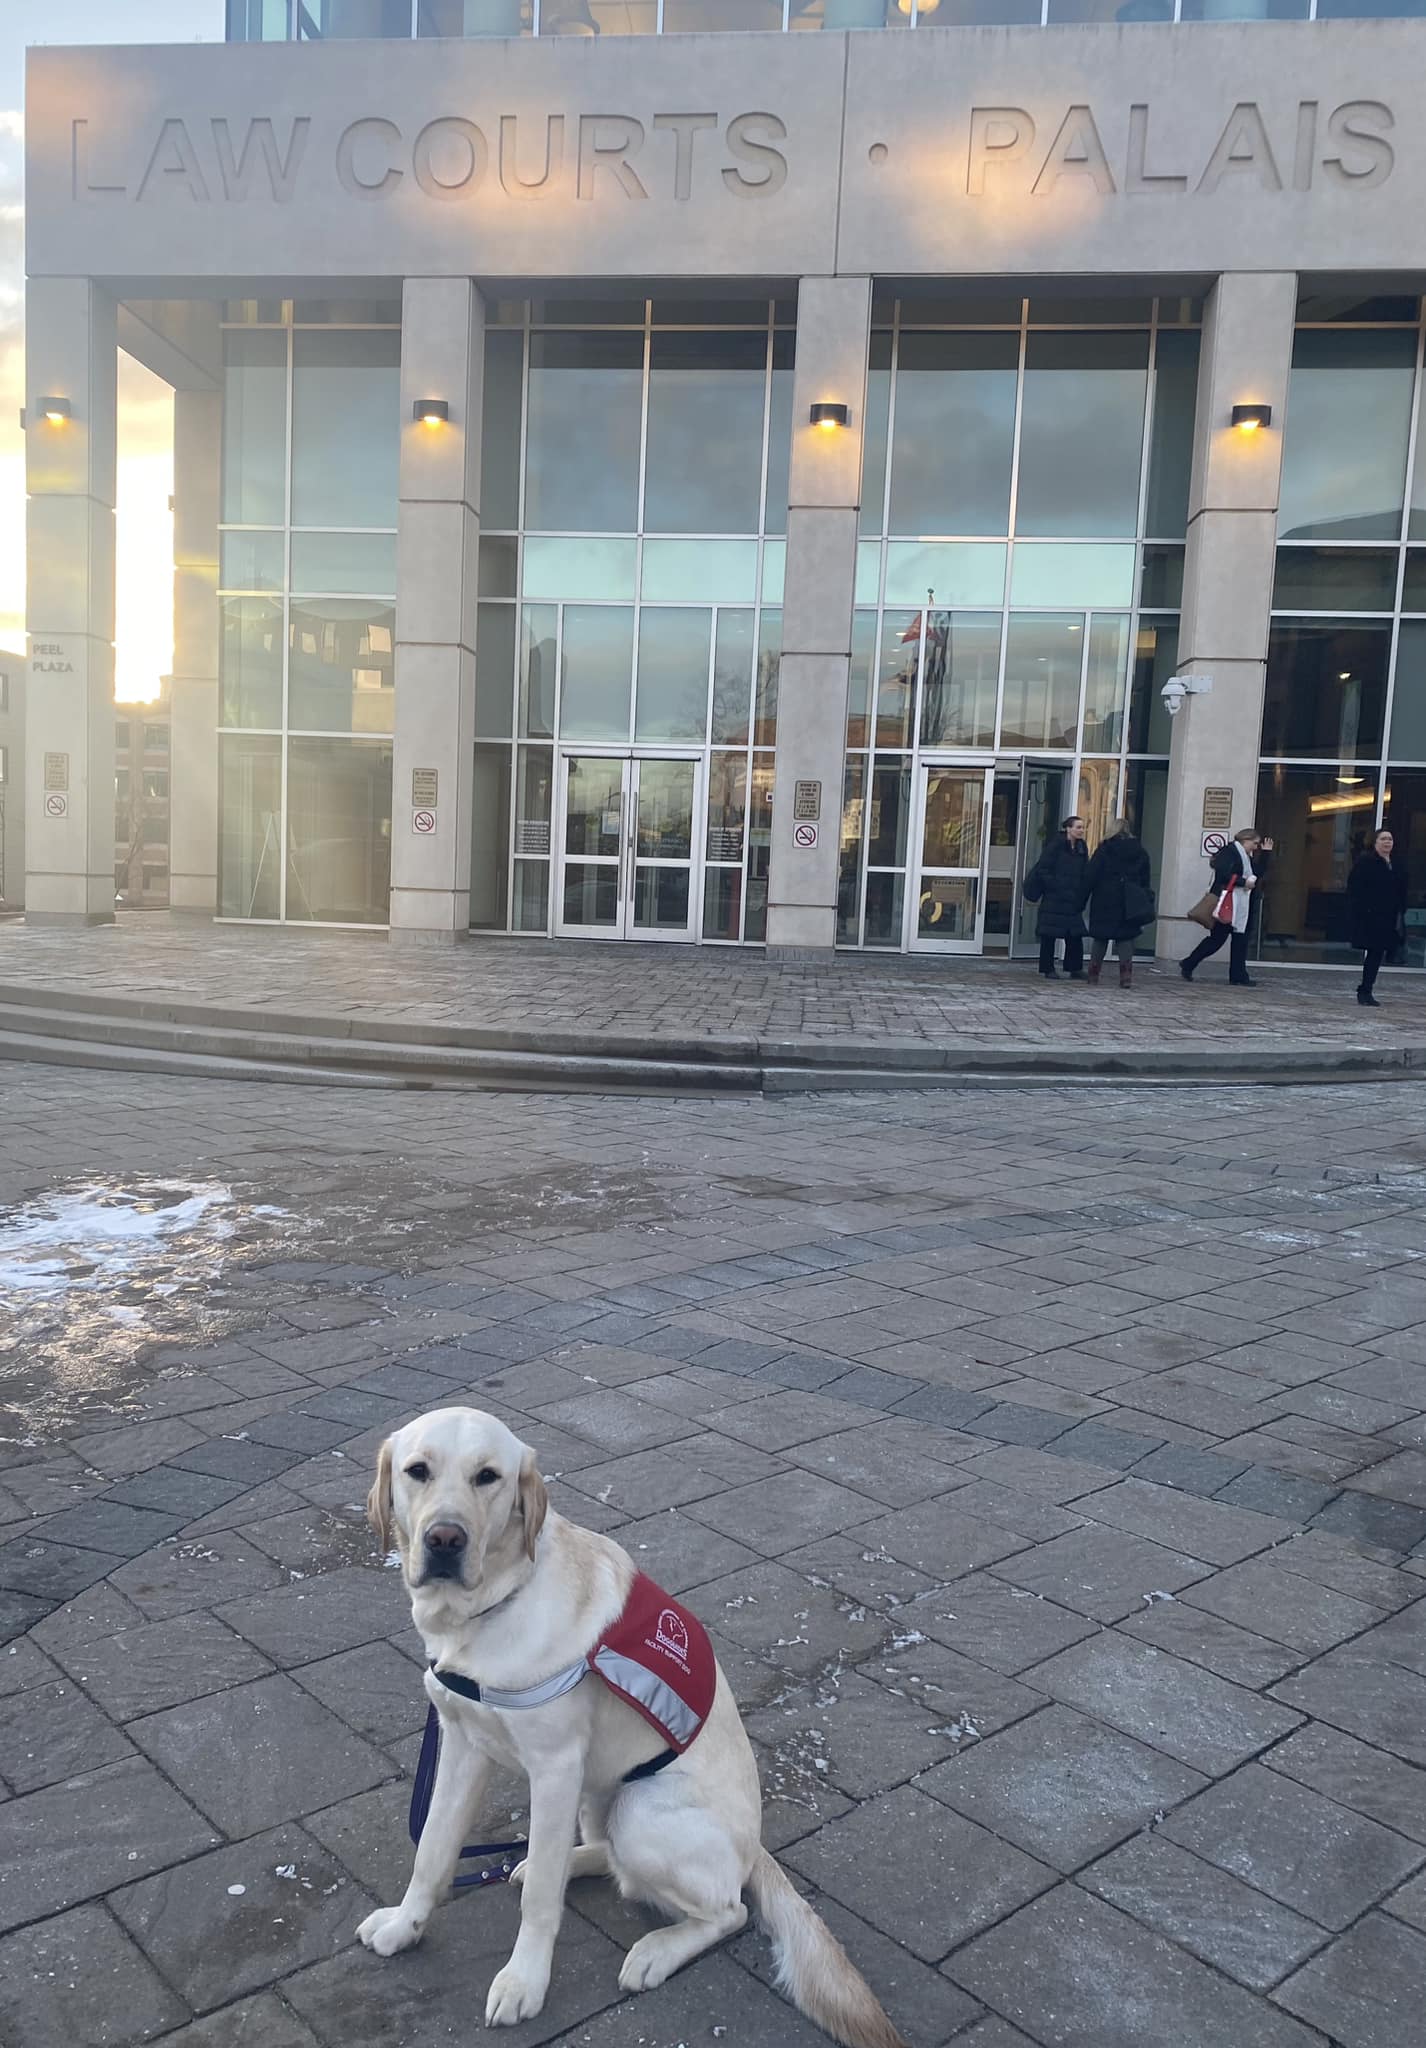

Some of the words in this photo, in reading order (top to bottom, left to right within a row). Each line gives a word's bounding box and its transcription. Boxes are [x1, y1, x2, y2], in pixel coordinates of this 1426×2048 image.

[71, 116, 312, 201] LAW
[335, 110, 789, 201] COURTS
[965, 100, 1396, 196] PALAIS
[32, 643, 64, 656] PEEL
[32, 661, 74, 673] PLAZA
